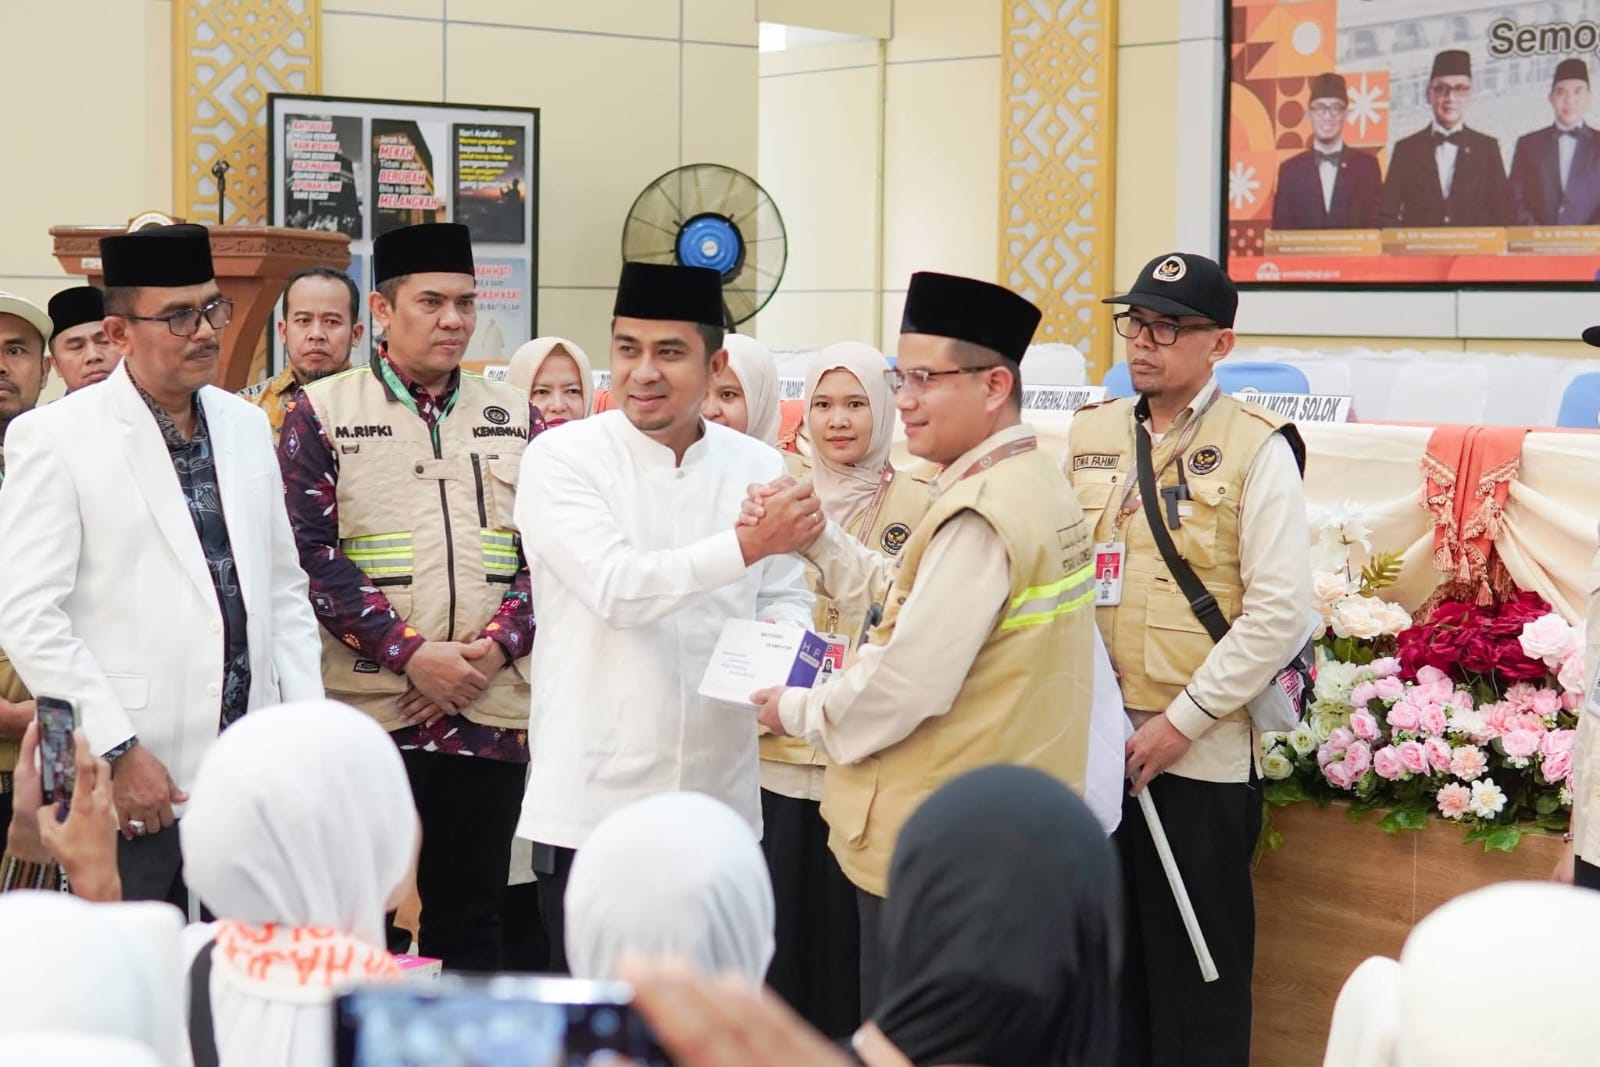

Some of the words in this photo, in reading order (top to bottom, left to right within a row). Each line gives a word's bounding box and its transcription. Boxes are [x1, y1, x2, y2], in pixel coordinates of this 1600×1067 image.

[1490, 20, 1600, 56] Semo
[379, 170, 426, 183] BERUBAH
[379, 195, 439, 208] MELANGKAH
[1299, 397, 1341, 422] SOLOK
[335, 425, 393, 438] M.RIFKI
[472, 426, 527, 440] KEMENHAJ
[1091, 456, 1116, 467] FAHMI
